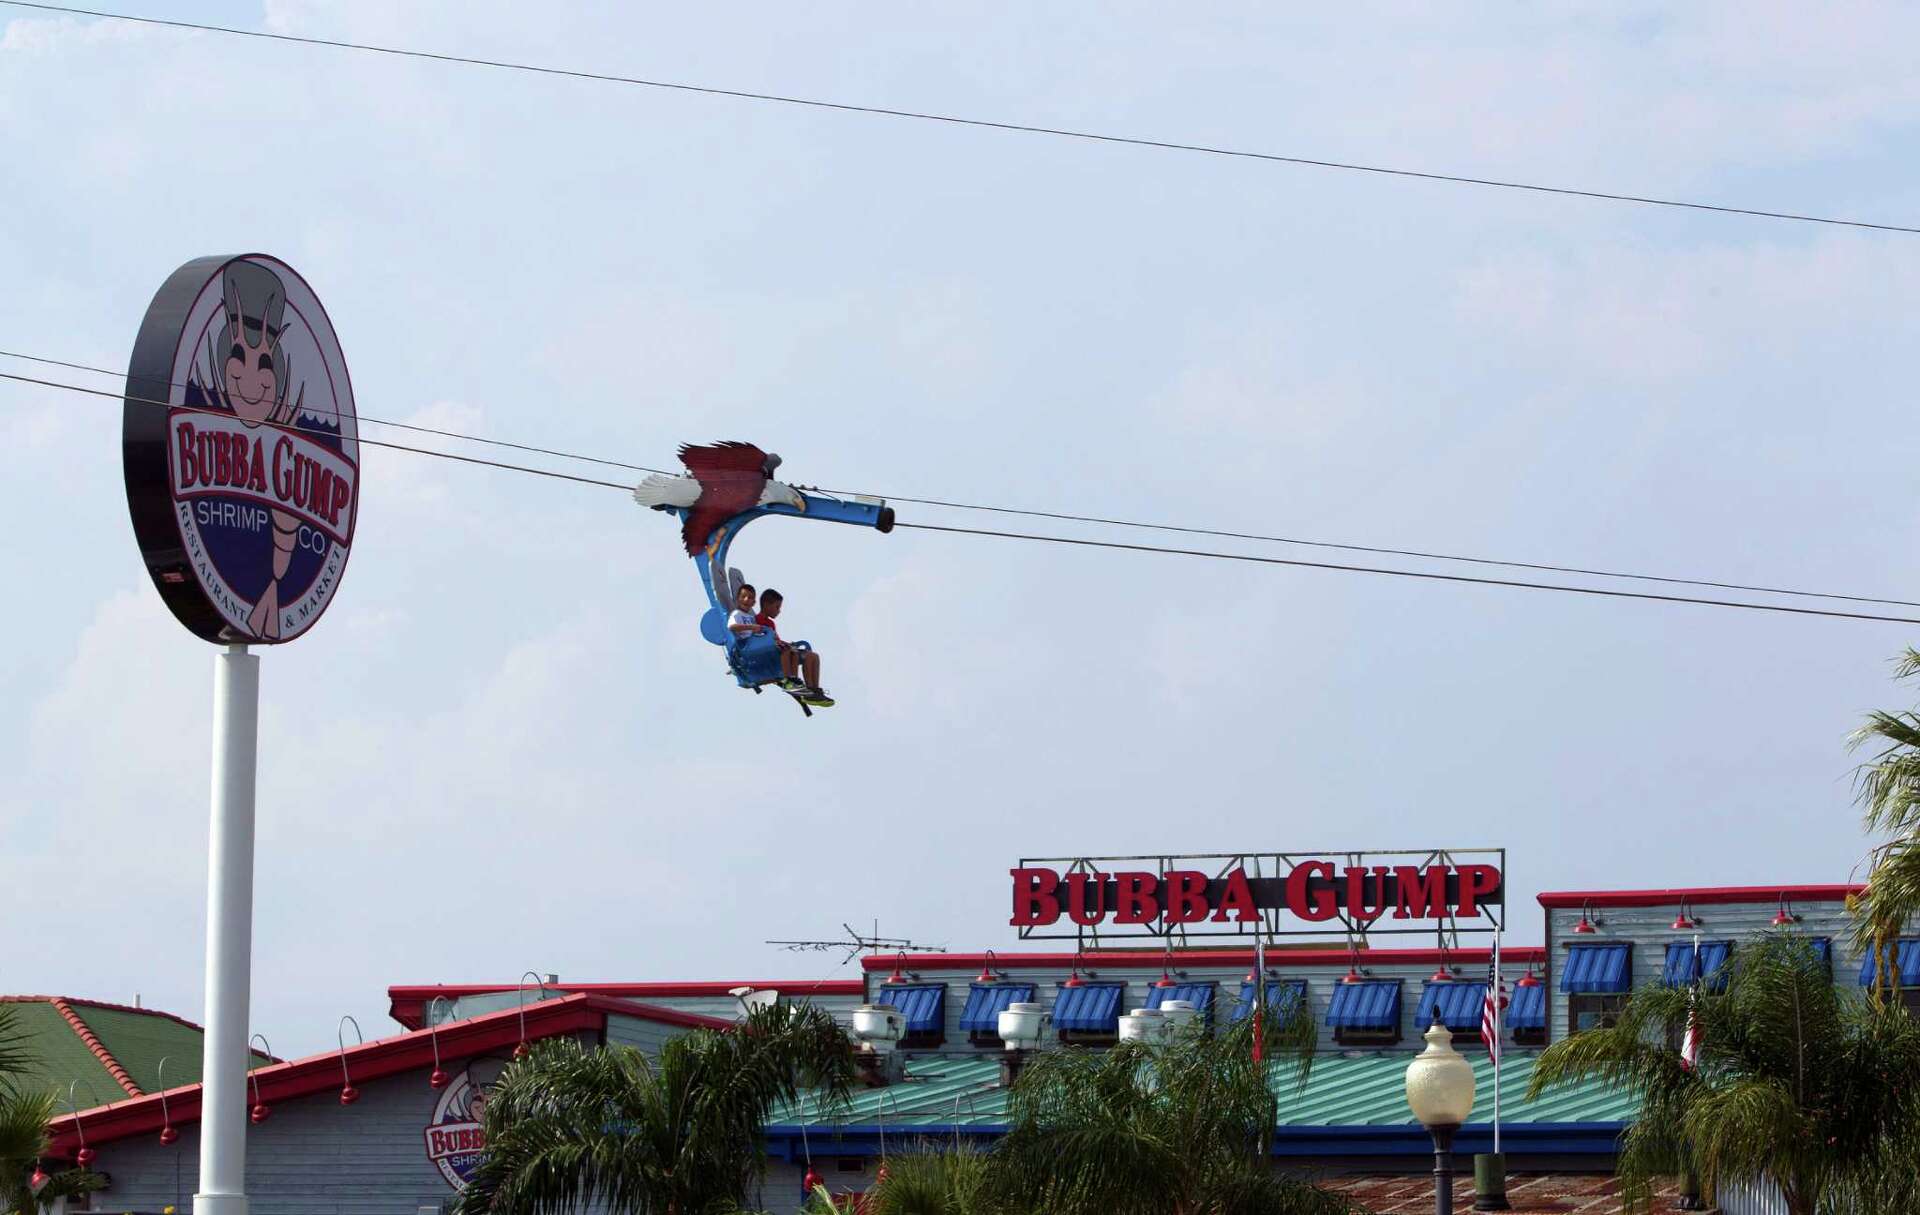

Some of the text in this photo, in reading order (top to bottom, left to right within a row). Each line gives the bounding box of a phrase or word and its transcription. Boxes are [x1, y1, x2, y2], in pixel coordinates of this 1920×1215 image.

[177, 421, 350, 527] BUBBA GUMP
[198, 501, 326, 557] SHRIMP CO.
[180, 503, 248, 622] RESTAURANT
[285, 547, 341, 629] & MARKET
[1009, 860, 1502, 926] BUBBA GUMP
[431, 1129, 487, 1154] BUBB
[451, 1153, 492, 1167] SHRIM
